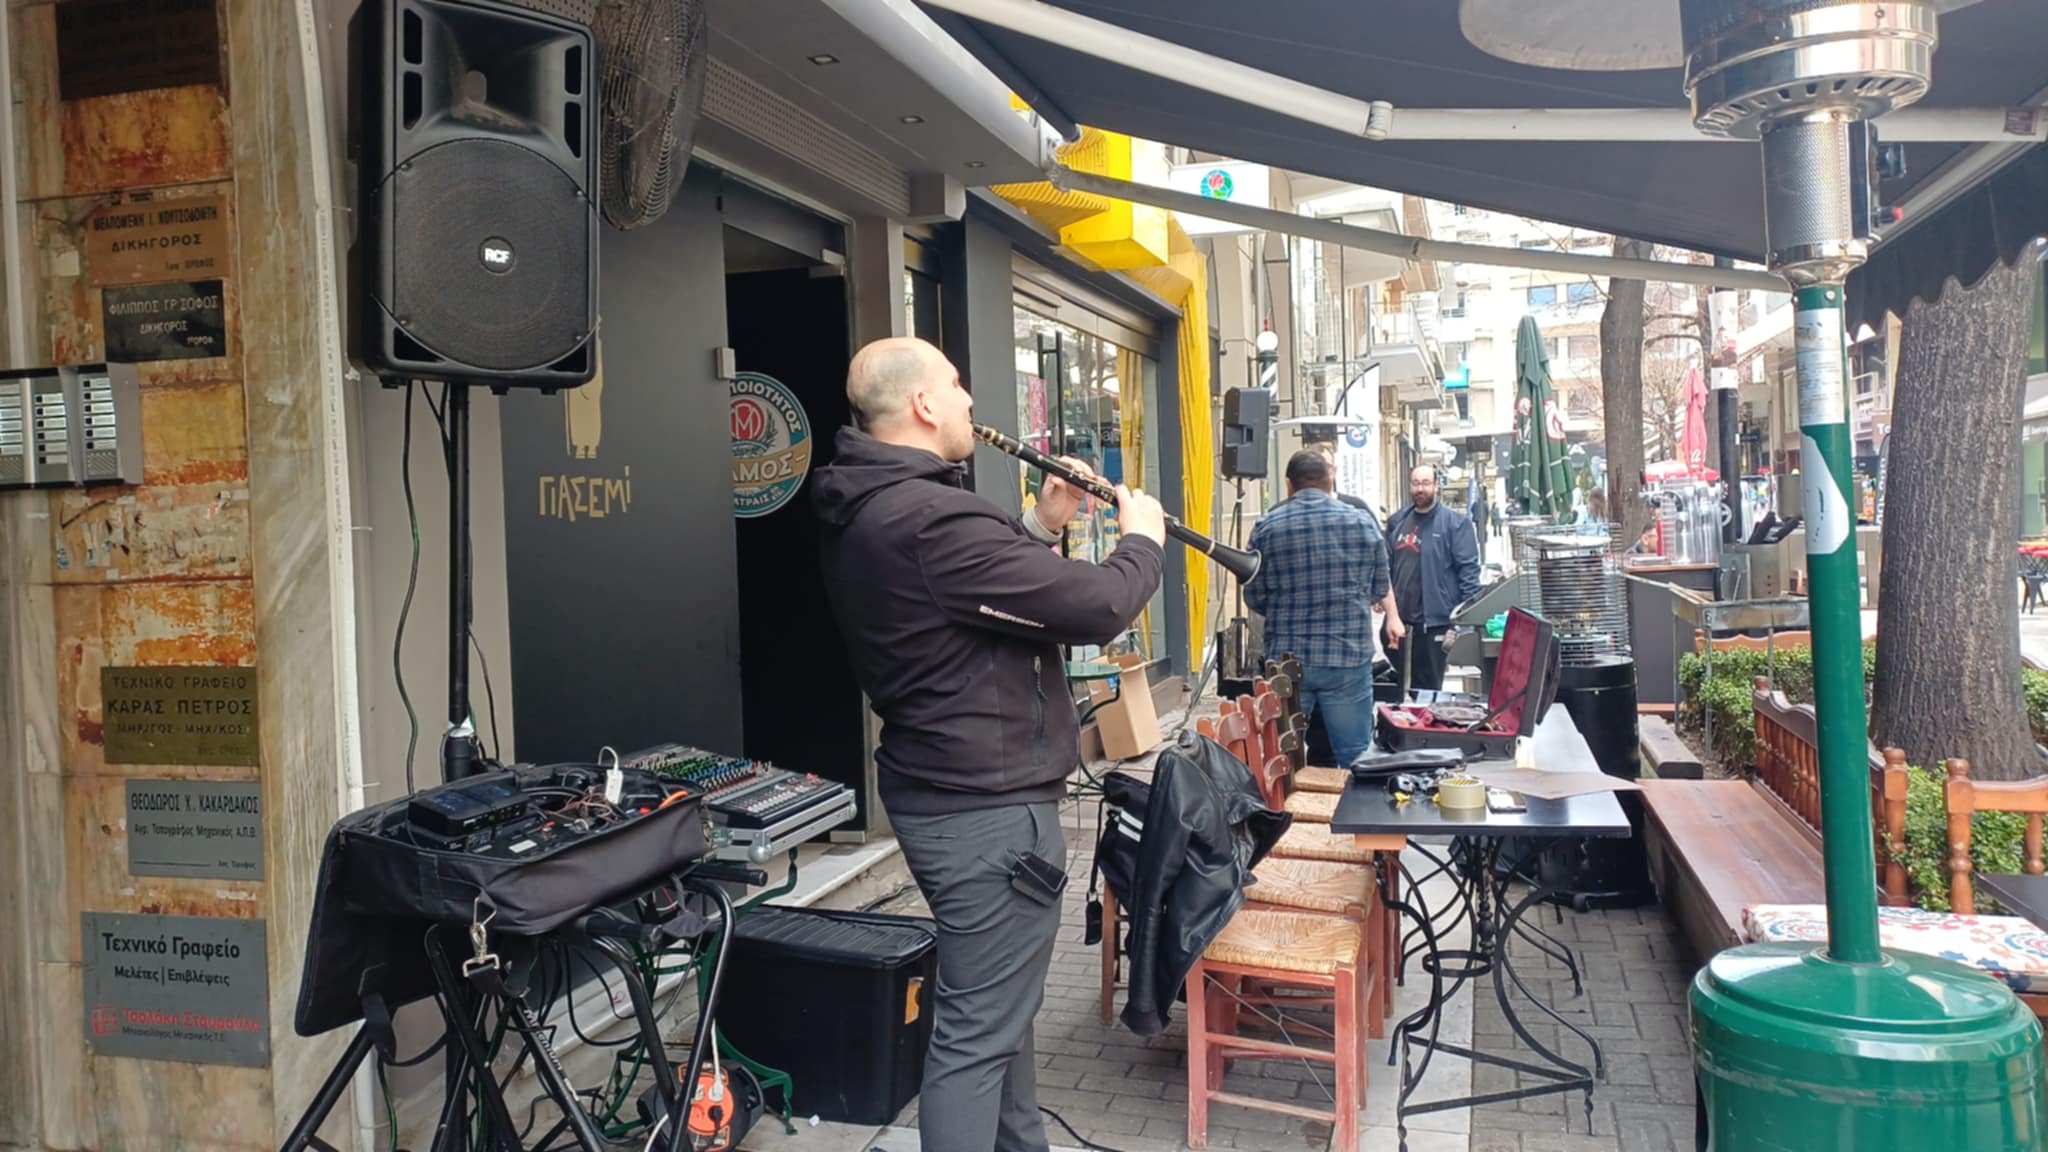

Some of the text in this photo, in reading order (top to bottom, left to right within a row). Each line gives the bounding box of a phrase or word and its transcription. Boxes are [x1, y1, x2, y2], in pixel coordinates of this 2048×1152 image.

[111, 233, 202, 252] ΔΙΚΗΓΟΡΟΣ
[485, 247, 510, 264] RCF
[108, 300, 160, 315] ΦΙΛΙΠΠΟΣ
[113, 676, 247, 689] ΤΕΧΝΙΚΟ ΓΡΑΦΕΙΟ
[107, 700, 252, 715] ΚΑΡΑΣ ΠΕΤΡΟΣ
[131, 793, 180, 811] ΘΕΟΔΩΡΟΣ
[199, 795, 258, 814] ΚΑΚΑΡΔΑΚΟΣ
[102, 933, 240, 961] Τεχνικό Γραφείο
[115, 966, 230, 987] Μελέτες Επιβλέψεις
